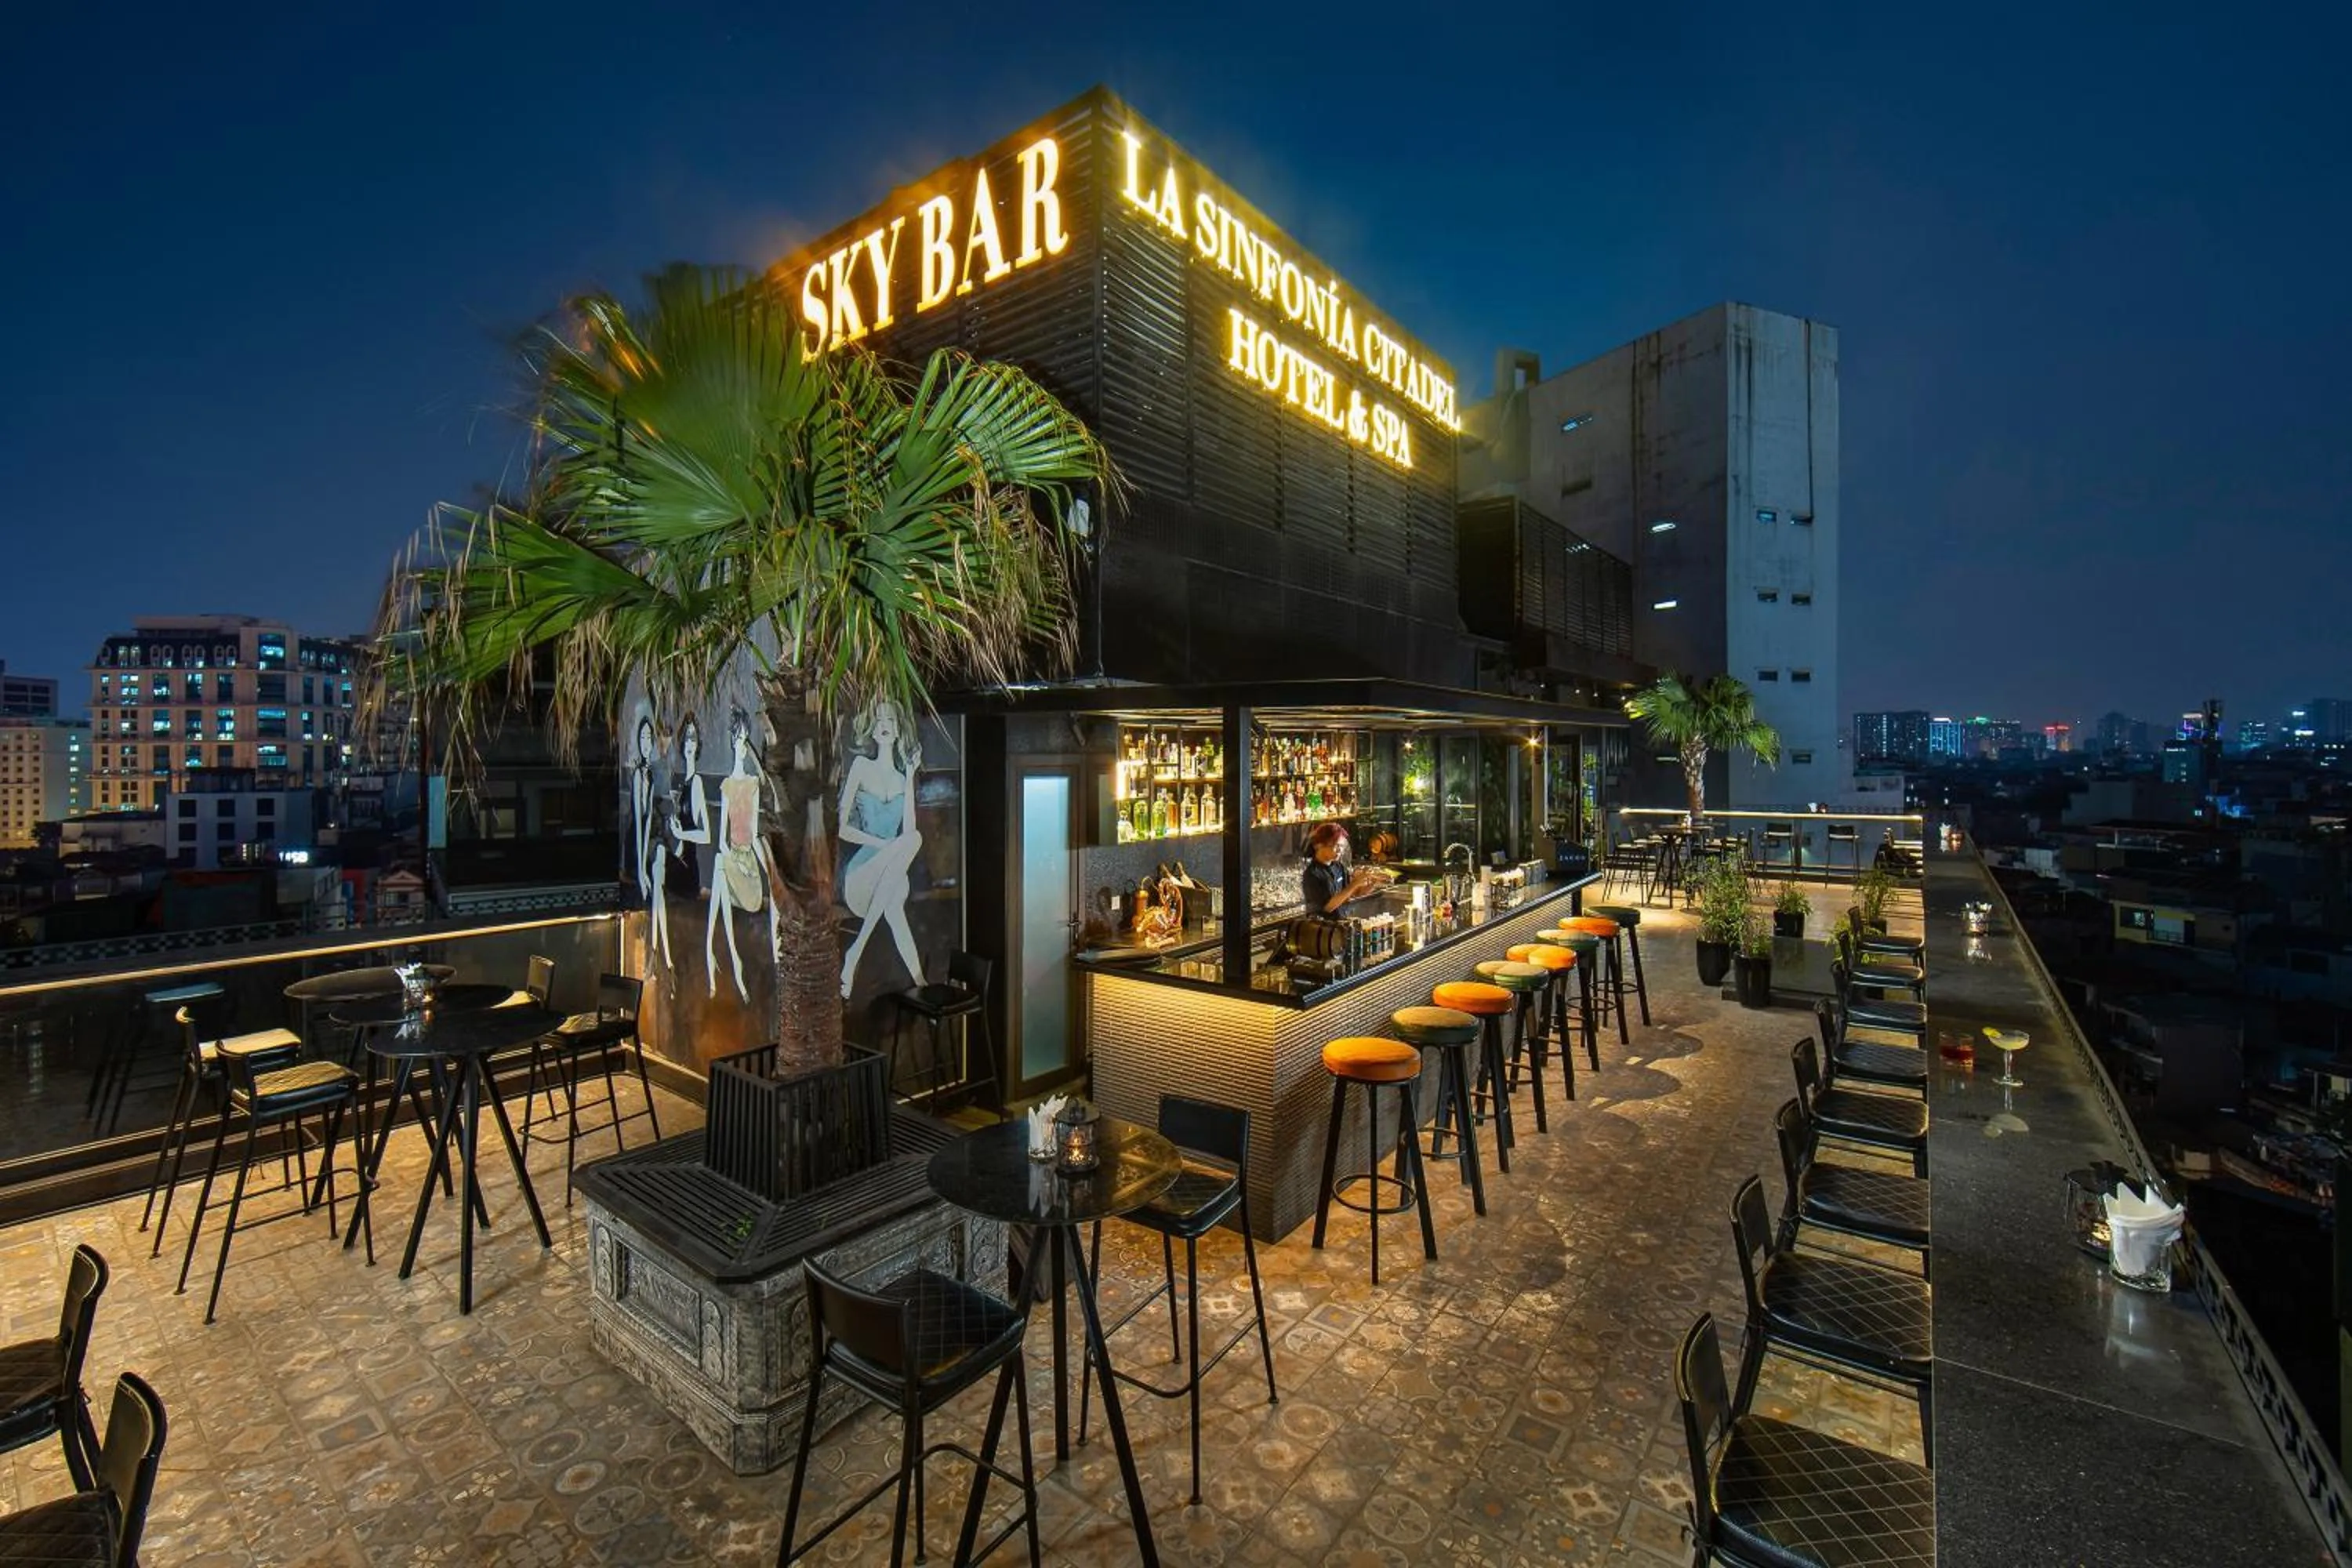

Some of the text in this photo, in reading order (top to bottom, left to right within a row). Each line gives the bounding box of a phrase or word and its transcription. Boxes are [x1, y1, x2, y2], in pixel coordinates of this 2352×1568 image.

[801, 138, 1069, 365] SKY BAR
[1121, 130, 1463, 433] LA SINFONÍA CITADEL
[1227, 308, 1413, 469] HOTEL & SPA
